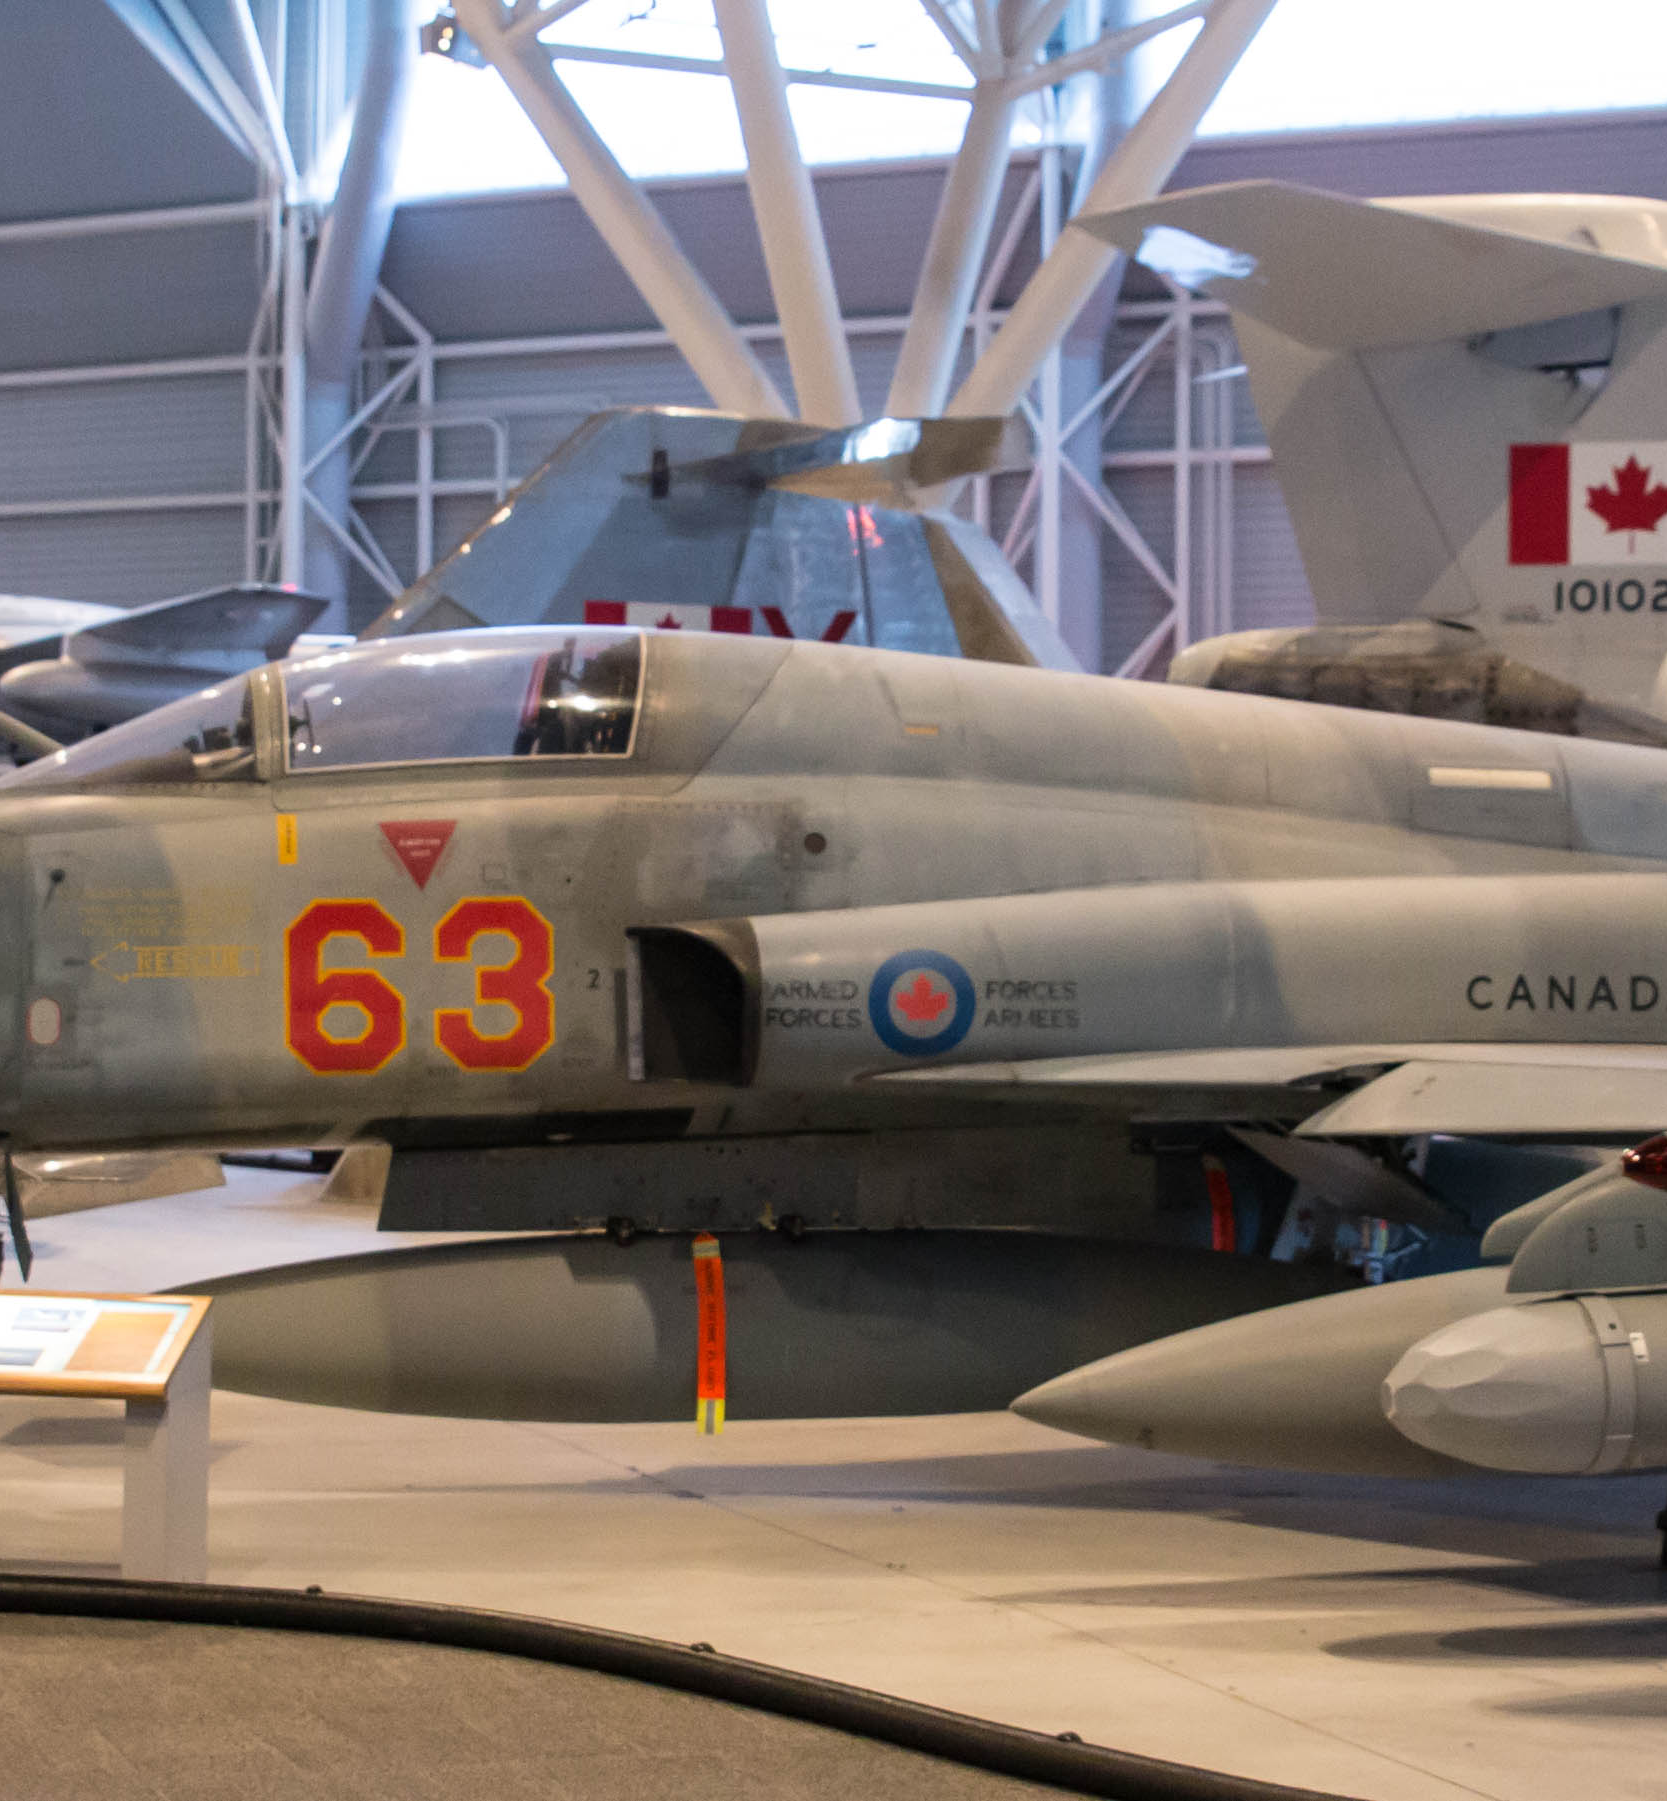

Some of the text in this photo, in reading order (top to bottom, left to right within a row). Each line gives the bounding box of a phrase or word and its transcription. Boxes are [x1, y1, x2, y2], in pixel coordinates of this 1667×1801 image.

[284, 896, 554, 1076] 63
[771, 980, 859, 1001] ARMED
[984, 978, 1079, 1001] FORCES
[764, 1007, 863, 1029] FORCES
